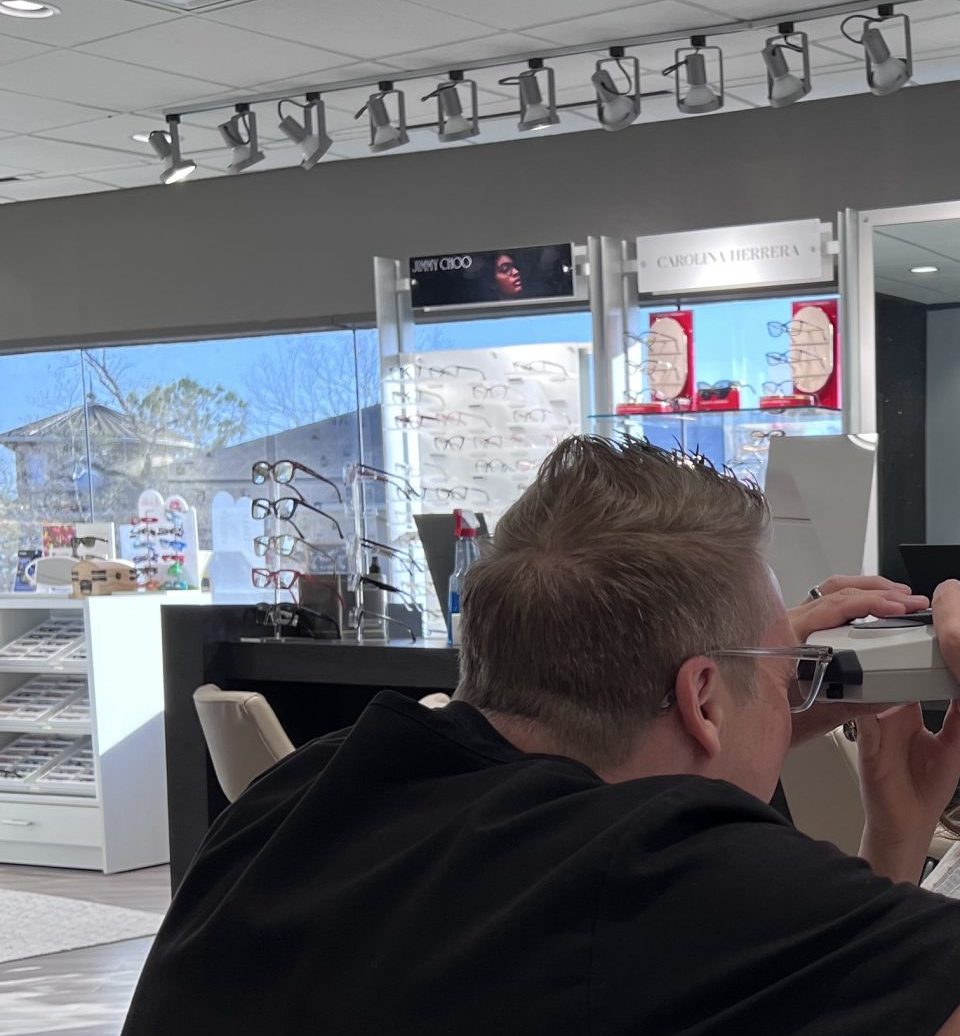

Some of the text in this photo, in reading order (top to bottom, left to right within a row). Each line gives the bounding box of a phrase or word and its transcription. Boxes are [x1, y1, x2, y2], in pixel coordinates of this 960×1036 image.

[411, 255, 472, 273] JIMMY CHOO
[657, 245, 800, 269] CAROLINA HERRERA
